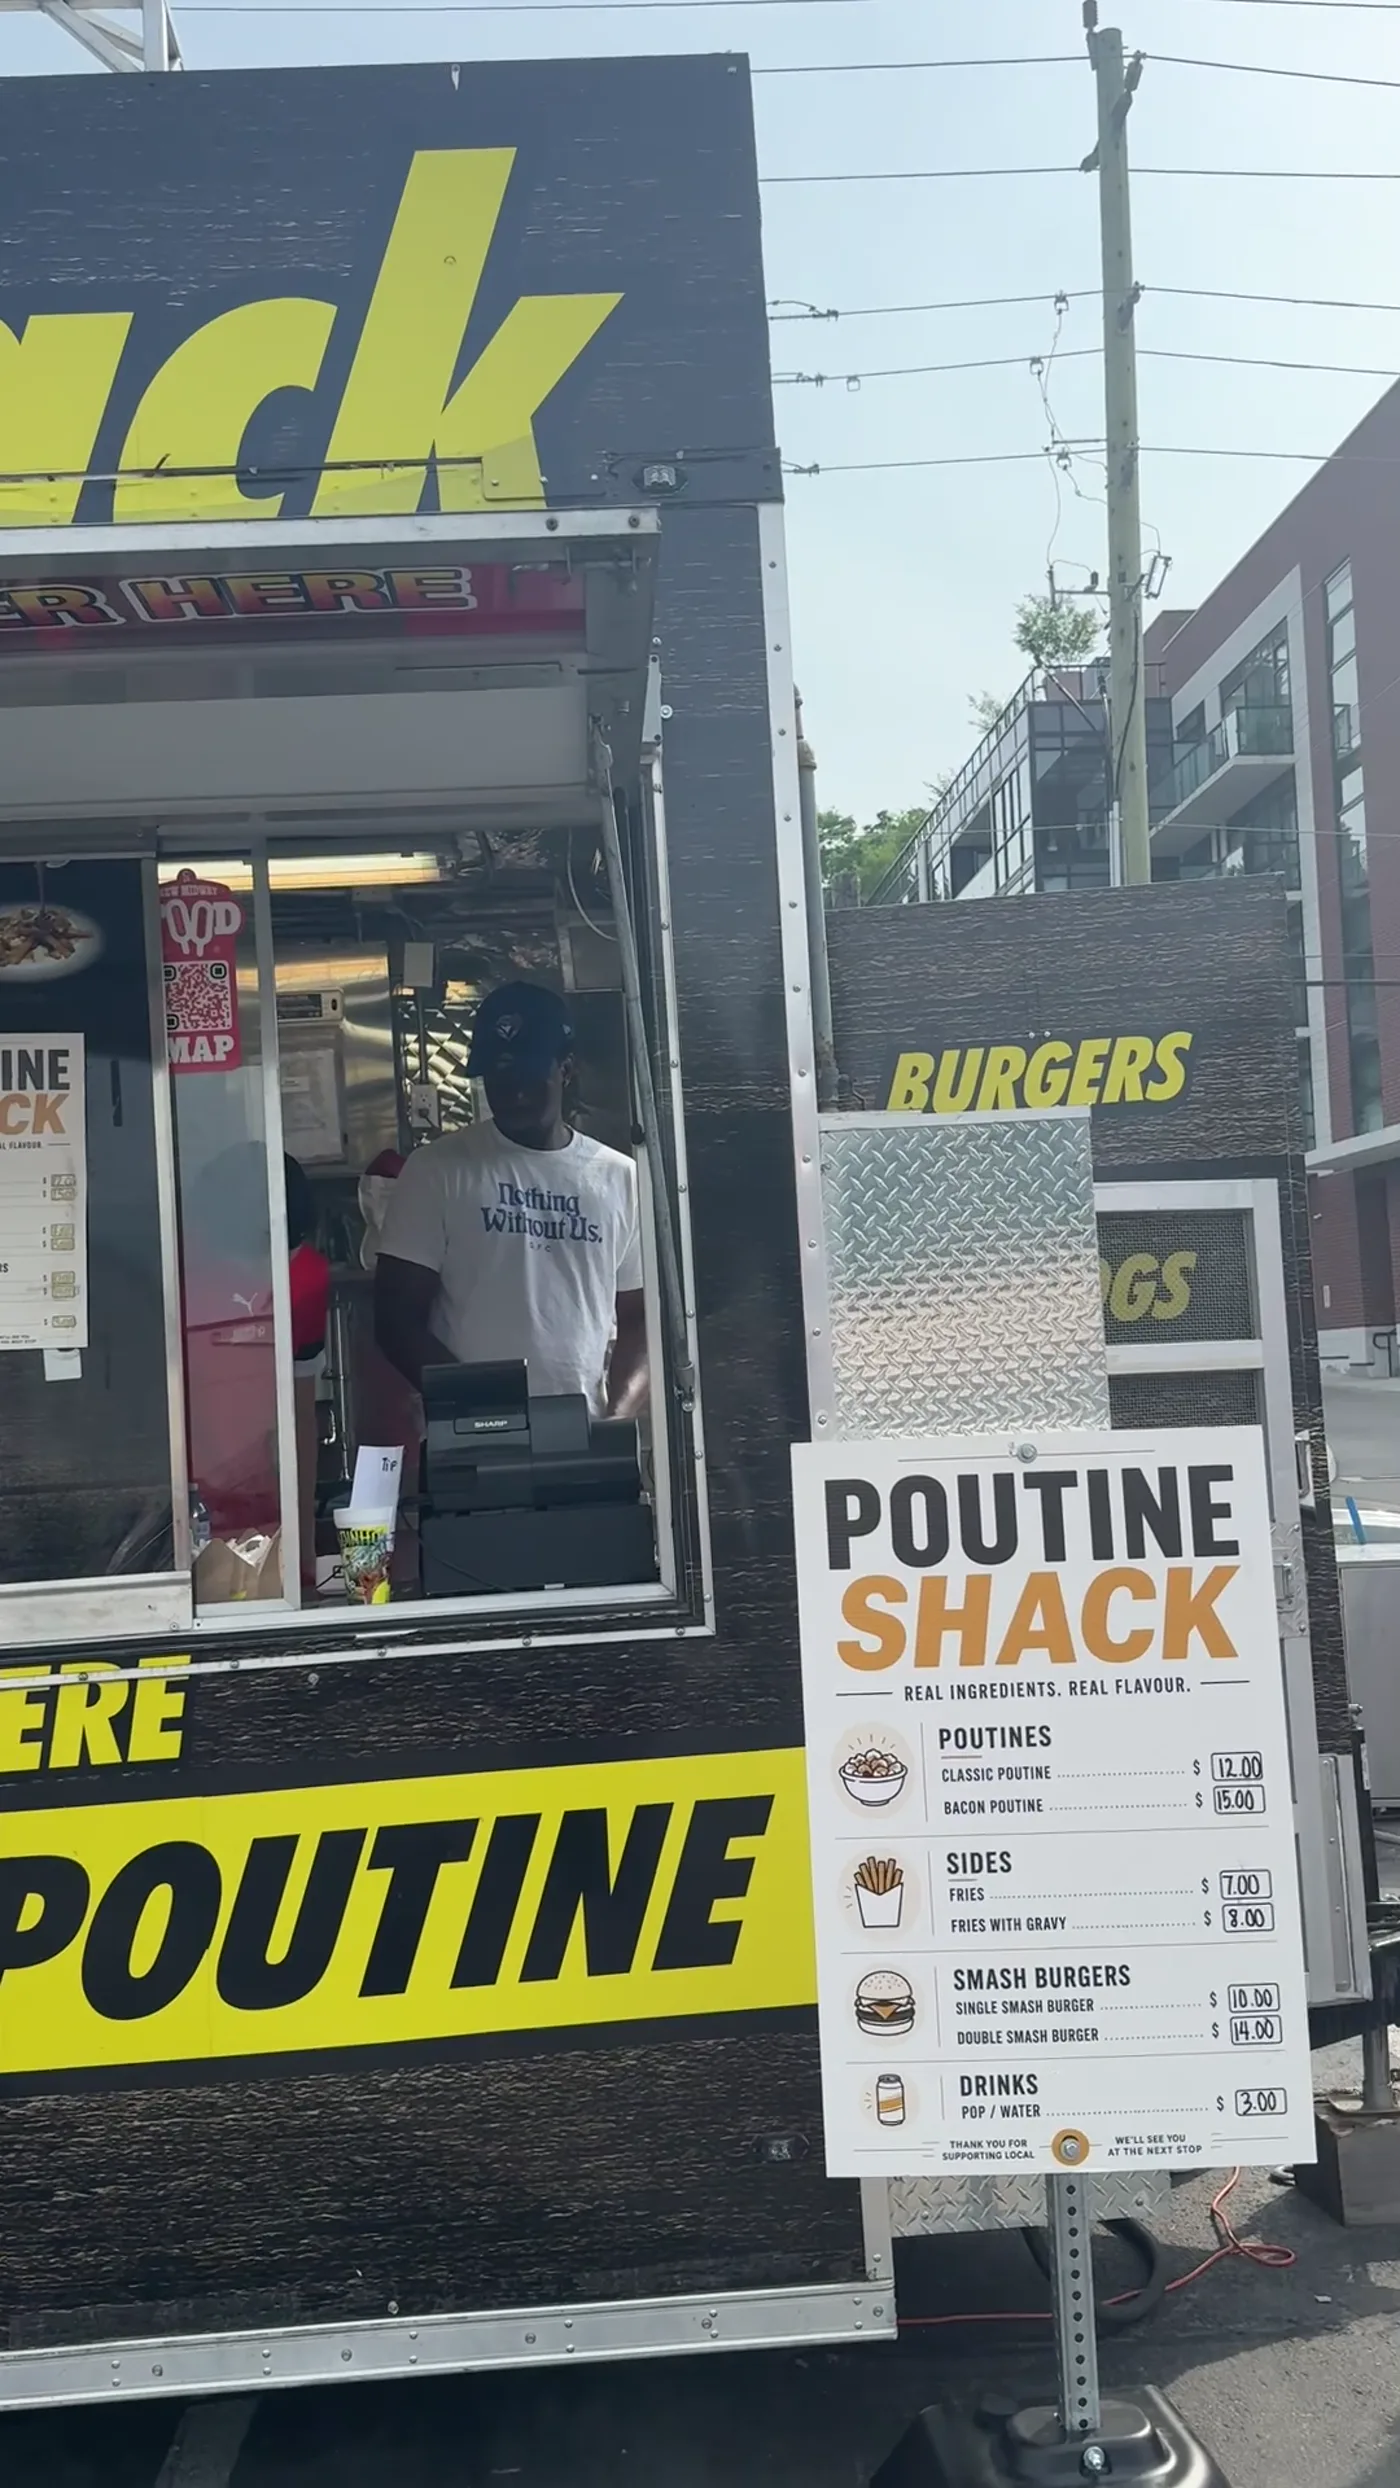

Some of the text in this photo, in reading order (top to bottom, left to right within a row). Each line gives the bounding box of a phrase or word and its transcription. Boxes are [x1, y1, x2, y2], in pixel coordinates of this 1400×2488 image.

[122, 567, 477, 623] HERE
[168, 1035, 234, 1064] MAP
[1, 1049, 70, 1091] INE
[887, 1031, 1194, 1113] BURGERS
[498, 1182, 580, 1217] Nothing
[481, 1207, 603, 1243] Without Us.
[1100, 1251, 1198, 1321] GS
[474, 1420, 508, 1428] SHARP
[825, 1465, 1239, 1570] POUTINE
[837, 1565, 1240, 1671] SHACK
[904, 1676, 1191, 1702] REAL INGREDIENTS. REAL FLAVOUR.
[938, 1725, 1052, 1750] POUTINES
[941, 1755, 1262, 1783] CLASSIC POUTINE $ 12.00
[944, 1790, 1254, 1815] BACON POUTINE $ 15.00
[946, 1850, 1012, 1875] SIDES
[949, 1874, 1260, 1902] FRIES $ 7.00
[0, 1793, 775, 2020] POUTINE
[951, 1908, 1265, 1933] FRIES WITH GRAVY $ 8.00
[953, 1964, 1131, 1991] SMASH BURGERS
[955, 1988, 1273, 2016] SINGLE SMASH BURGER $ 10.00
[957, 2017, 1274, 2045] DOUBLE SMASH BURGER $ 14.00
[960, 2073, 1038, 2097] DRINKS
[961, 2091, 1277, 2120] POP / WATER $ 3.00
[949, 2138, 1028, 2150] THANK YOU FOR
[1107, 2144, 1203, 2157] AT THE NEXT STOP
[1114, 2133, 1186, 2145] WE'LL SEE YOU
[942, 2150, 1035, 2161] SUPPORTING LOCAL
